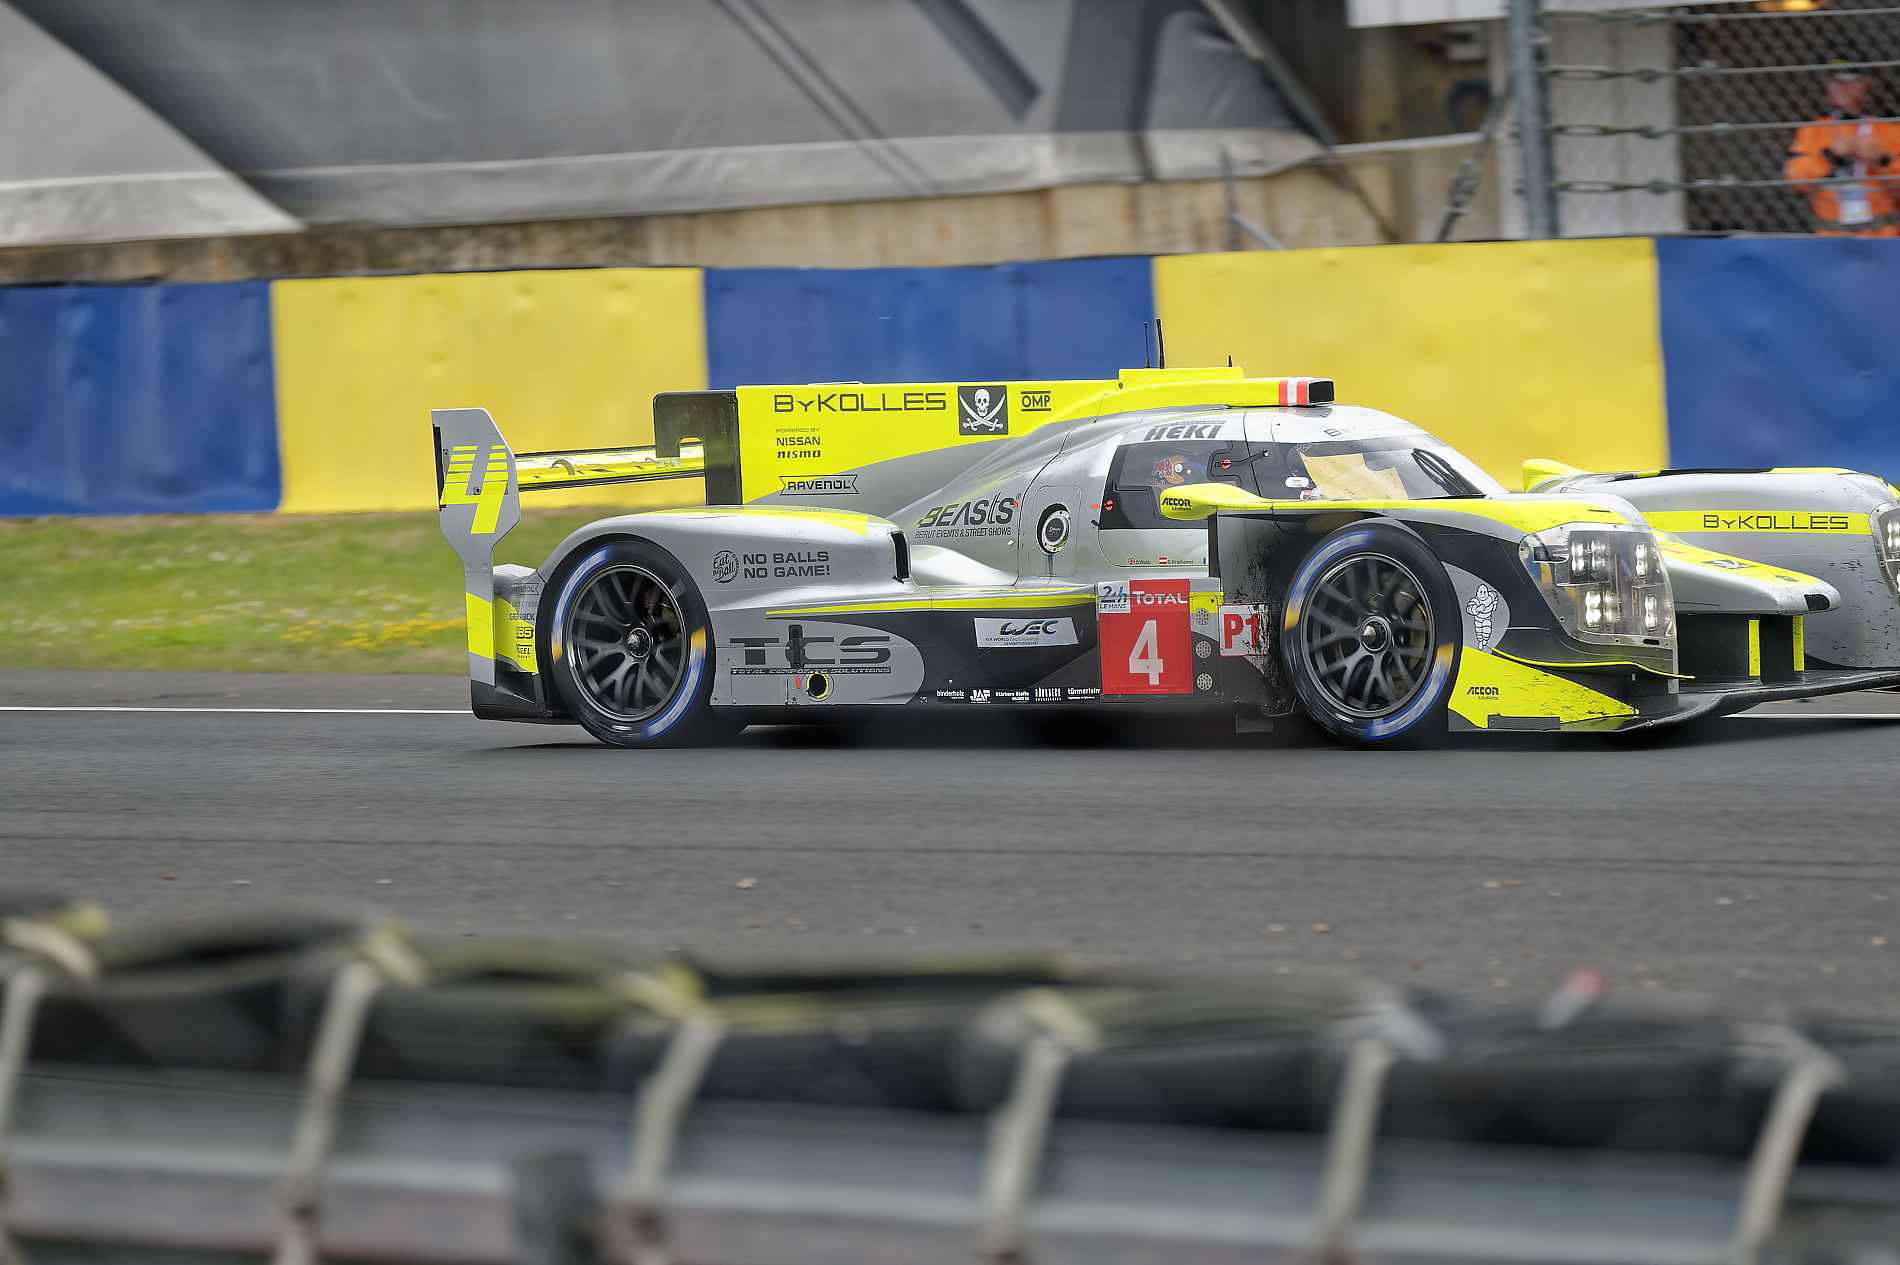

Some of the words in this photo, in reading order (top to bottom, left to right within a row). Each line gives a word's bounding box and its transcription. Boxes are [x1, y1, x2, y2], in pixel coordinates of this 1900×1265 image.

[1021, 395, 1050, 407] OMP
[1144, 424, 1222, 440] HEKI
[776, 436, 820, 446] NISSAN
[788, 480, 850, 490] RAVENOL
[1162, 497, 1192, 506] ACCOR
[915, 530, 936, 538] BEIRUT
[936, 529, 959, 537] EVENTS
[960, 529, 964, 537] &
[965, 527, 988, 537] STREET
[988, 526, 1011, 535] SHOWS
[713, 553, 729, 569] Eat
[743, 553, 767, 565] NO
[773, 551, 830, 563] BALLS
[719, 561, 736, 578] Ball
[744, 567, 768, 578] NO
[774, 565, 830, 577] GAME!
[1133, 591, 1188, 604] TOTAL
[1000, 620, 1058, 635] WEC
[1223, 613, 1260, 649] P1
[730, 636, 890, 665] TCS
[1129, 620, 1164, 685] 4
[970, 689, 990, 701] JAF
[1467, 686, 1499, 695] ACCOR
